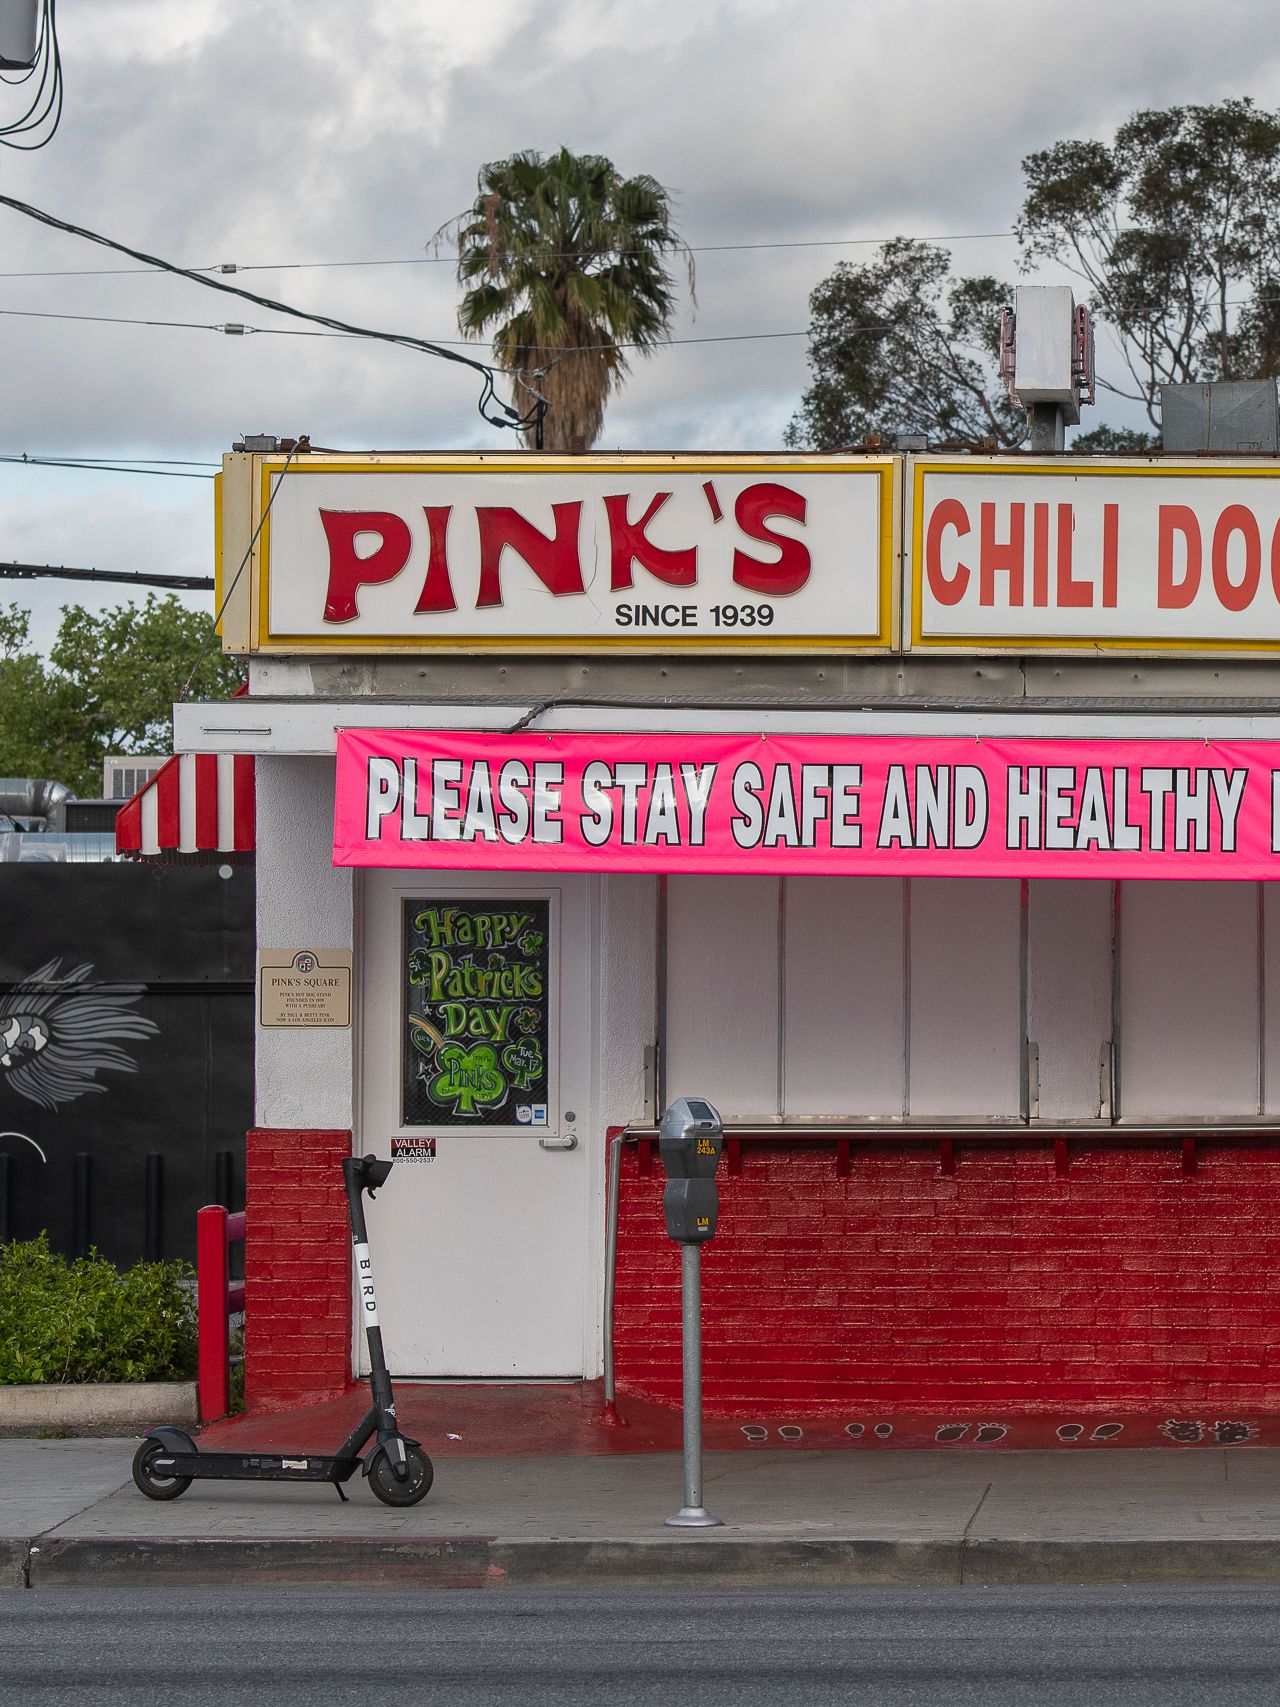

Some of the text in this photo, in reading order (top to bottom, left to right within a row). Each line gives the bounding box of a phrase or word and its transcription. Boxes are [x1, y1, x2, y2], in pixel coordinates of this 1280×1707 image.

[319, 480, 811, 624] PINK'S
[926, 498, 1119, 608] CHILI
[615, 603, 774, 628] SINCE 1939
[365, 756, 565, 845] PLEASE
[579, 759, 720, 847] STAY
[731, 760, 863, 849] SAFE
[876, 763, 990, 850] AND
[1005, 765, 1249, 853] HEALTHY
[414, 908, 530, 947] Happy
[271, 978, 340, 988] PINK'S SQUARE
[439, 1003, 517, 1041] Day
[394, 1139, 432, 1148] VALLEY
[396, 1148, 431, 1157] ALARM
[697, 1147, 716, 1155] 243A
[698, 1139, 709, 1147] LM
[697, 1218, 709, 1226] LM
[360, 1258, 377, 1312] BIRD
